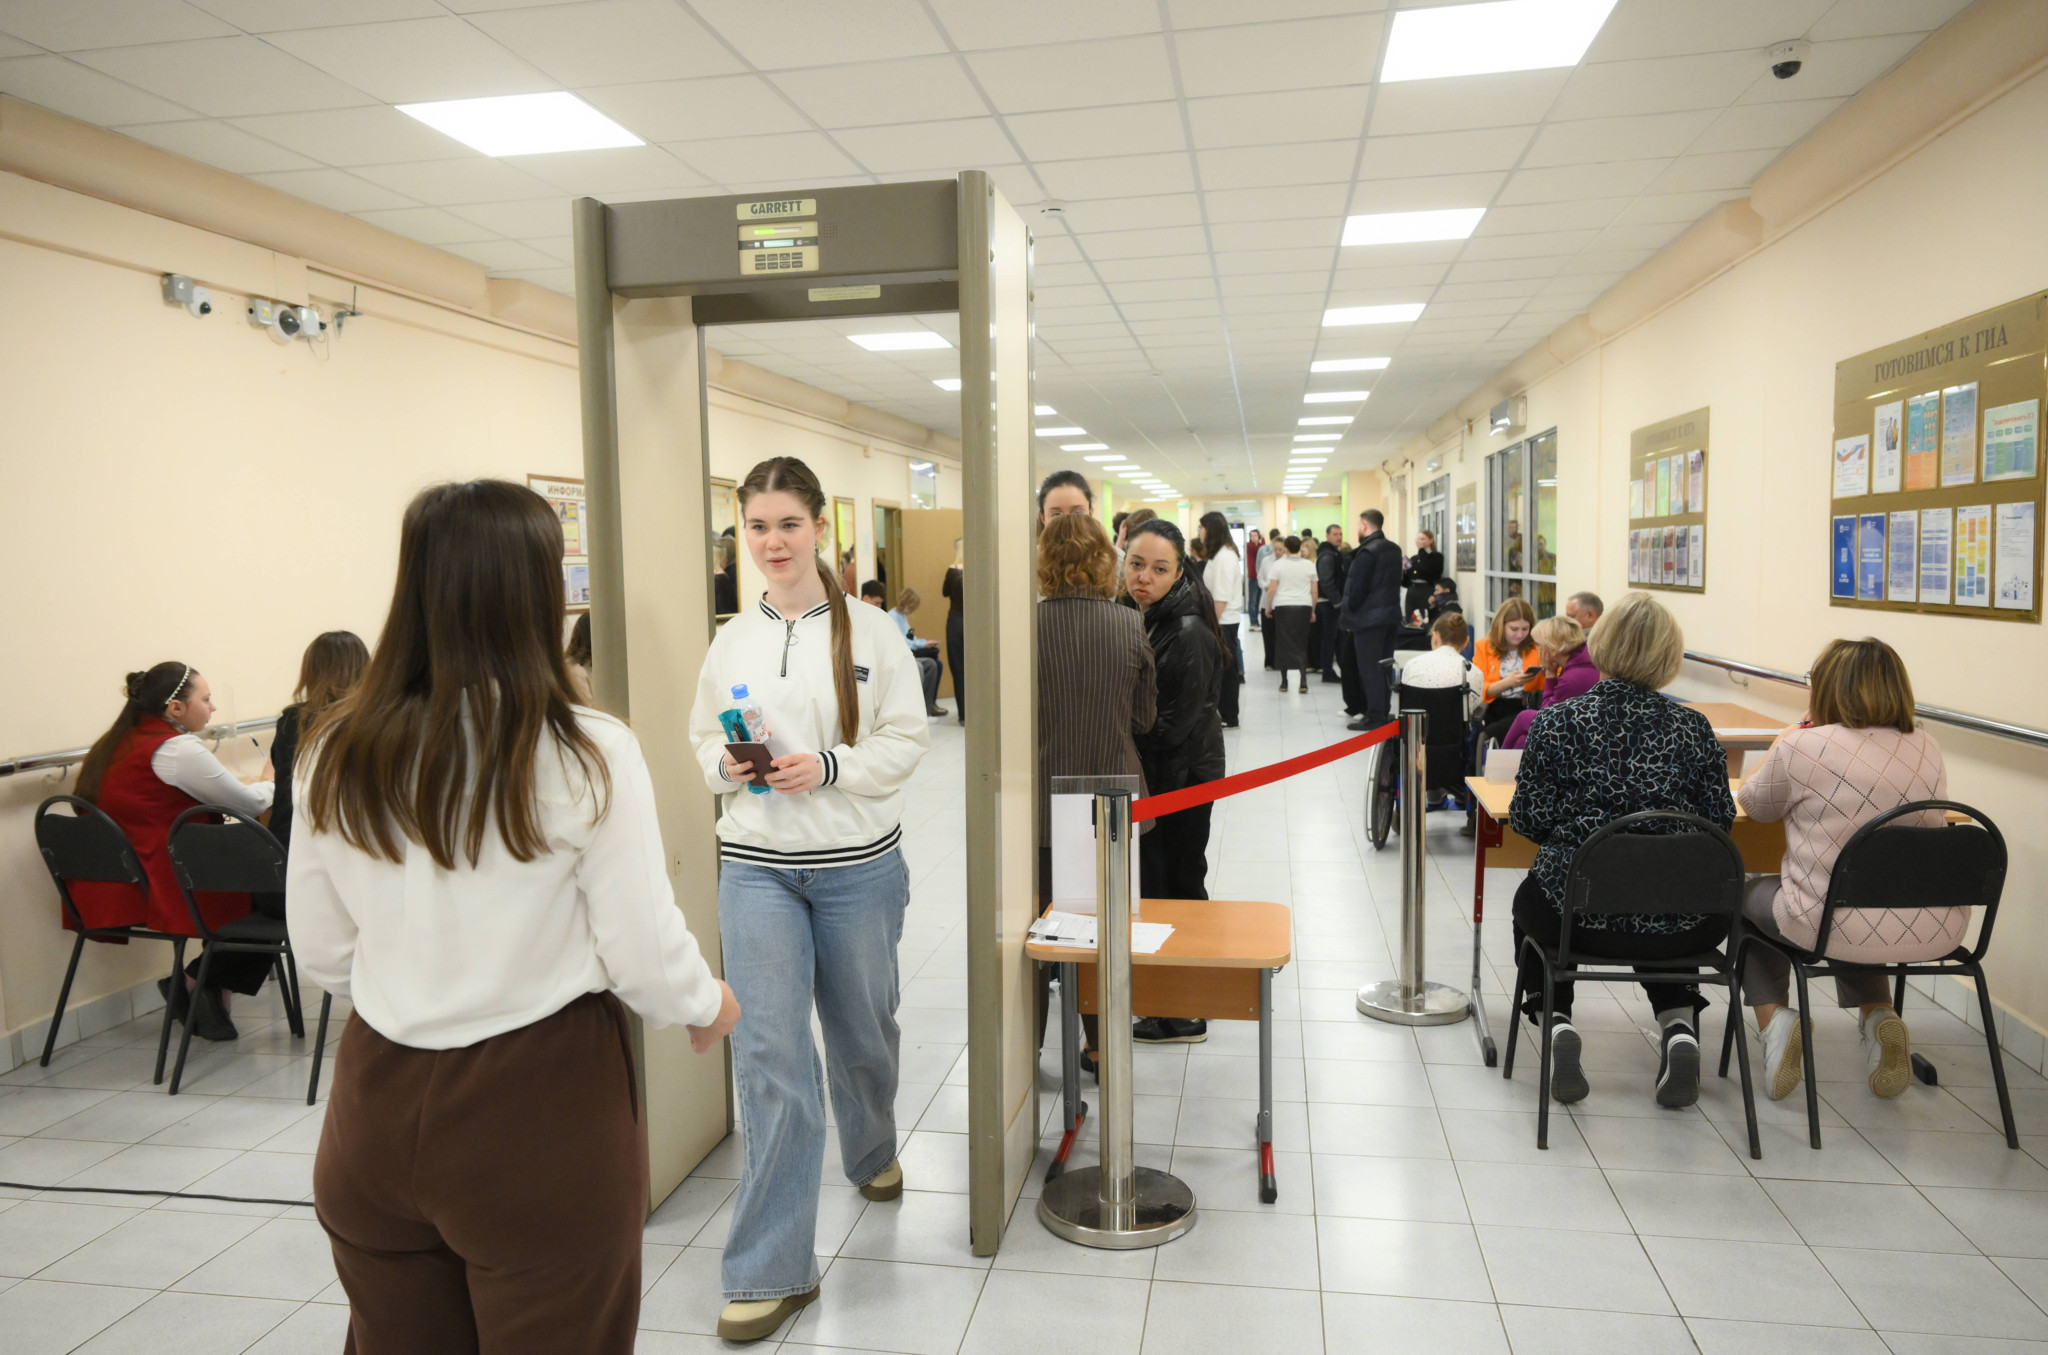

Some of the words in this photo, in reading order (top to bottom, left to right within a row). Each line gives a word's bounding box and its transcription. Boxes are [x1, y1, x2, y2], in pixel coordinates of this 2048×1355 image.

[750, 200, 802, 214] GARRETT
[1874, 340, 1954, 383] ГОТОВИМСЯ
[1959, 335, 1970, 359] К
[1974, 324, 2008, 354] ГИА
